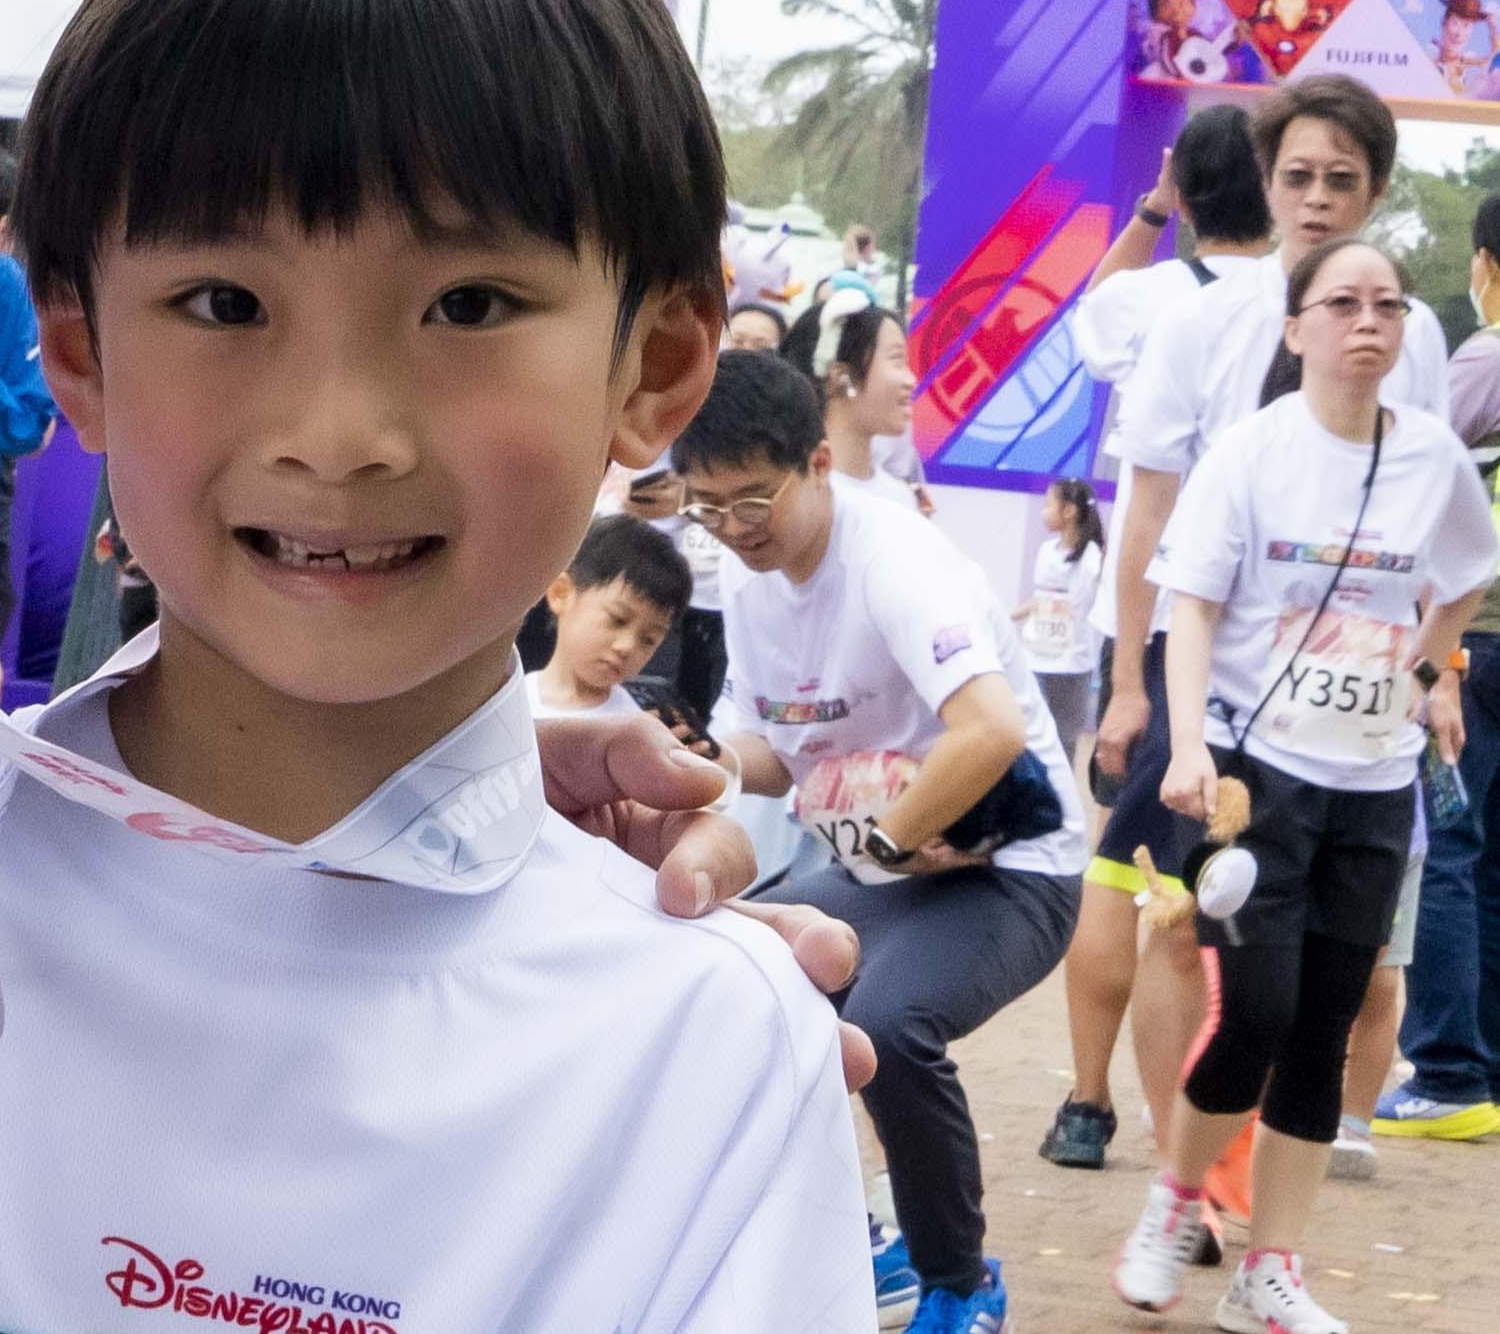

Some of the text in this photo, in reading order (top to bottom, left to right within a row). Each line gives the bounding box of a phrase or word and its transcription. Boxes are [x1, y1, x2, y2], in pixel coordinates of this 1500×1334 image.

[1326, 48, 1409, 66] FUJIFILM
[253, 1273, 402, 1321] HONG KONG
